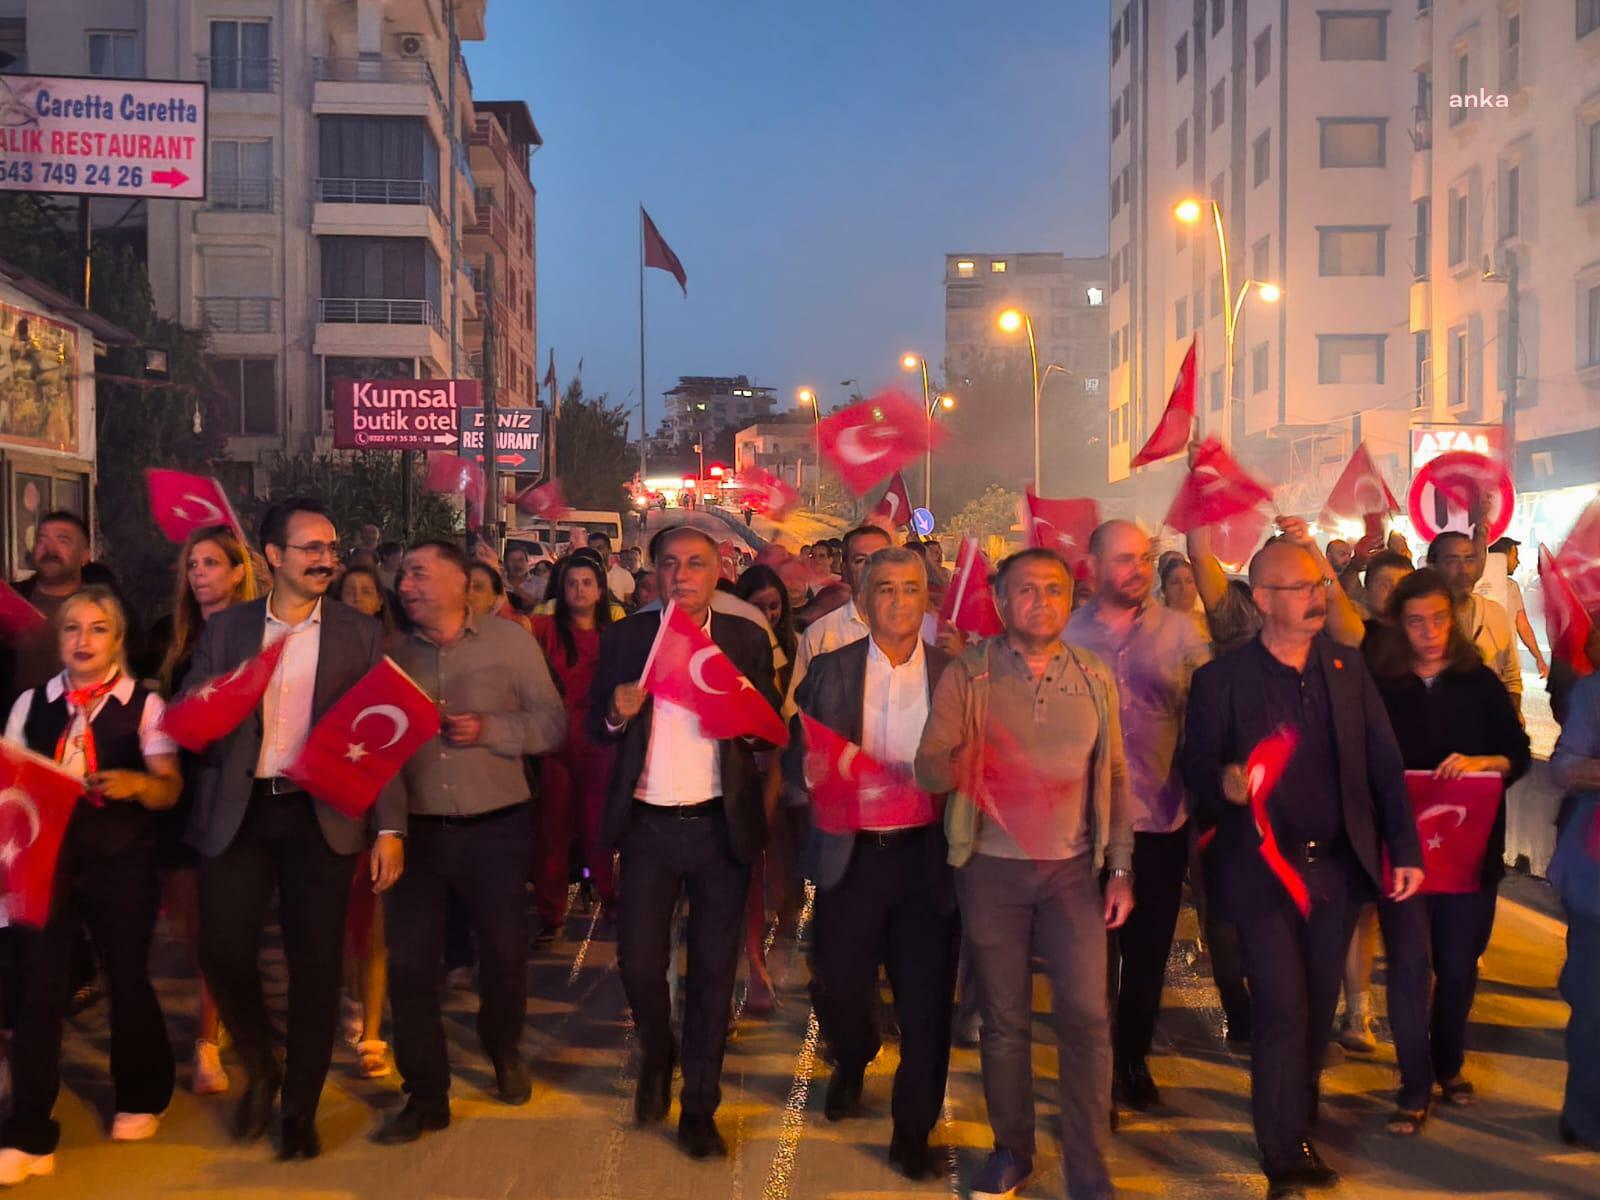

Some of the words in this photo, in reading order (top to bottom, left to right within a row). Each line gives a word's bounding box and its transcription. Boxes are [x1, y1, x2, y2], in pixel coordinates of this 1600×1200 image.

[36, 89, 113, 120] Caretta
[120, 93, 197, 123] Caretta
[51, 131, 196, 160] RESTAURANT
[41, 162, 77, 185] 749
[85, 164, 111, 186] 24
[117, 165, 143, 188] 26
[353, 381, 457, 408] Kumsal
[353, 409, 408, 431] butik
[414, 409, 458, 431] otel
[473, 411, 532, 428] DNİZ
[463, 431, 539, 450] RESURANT
